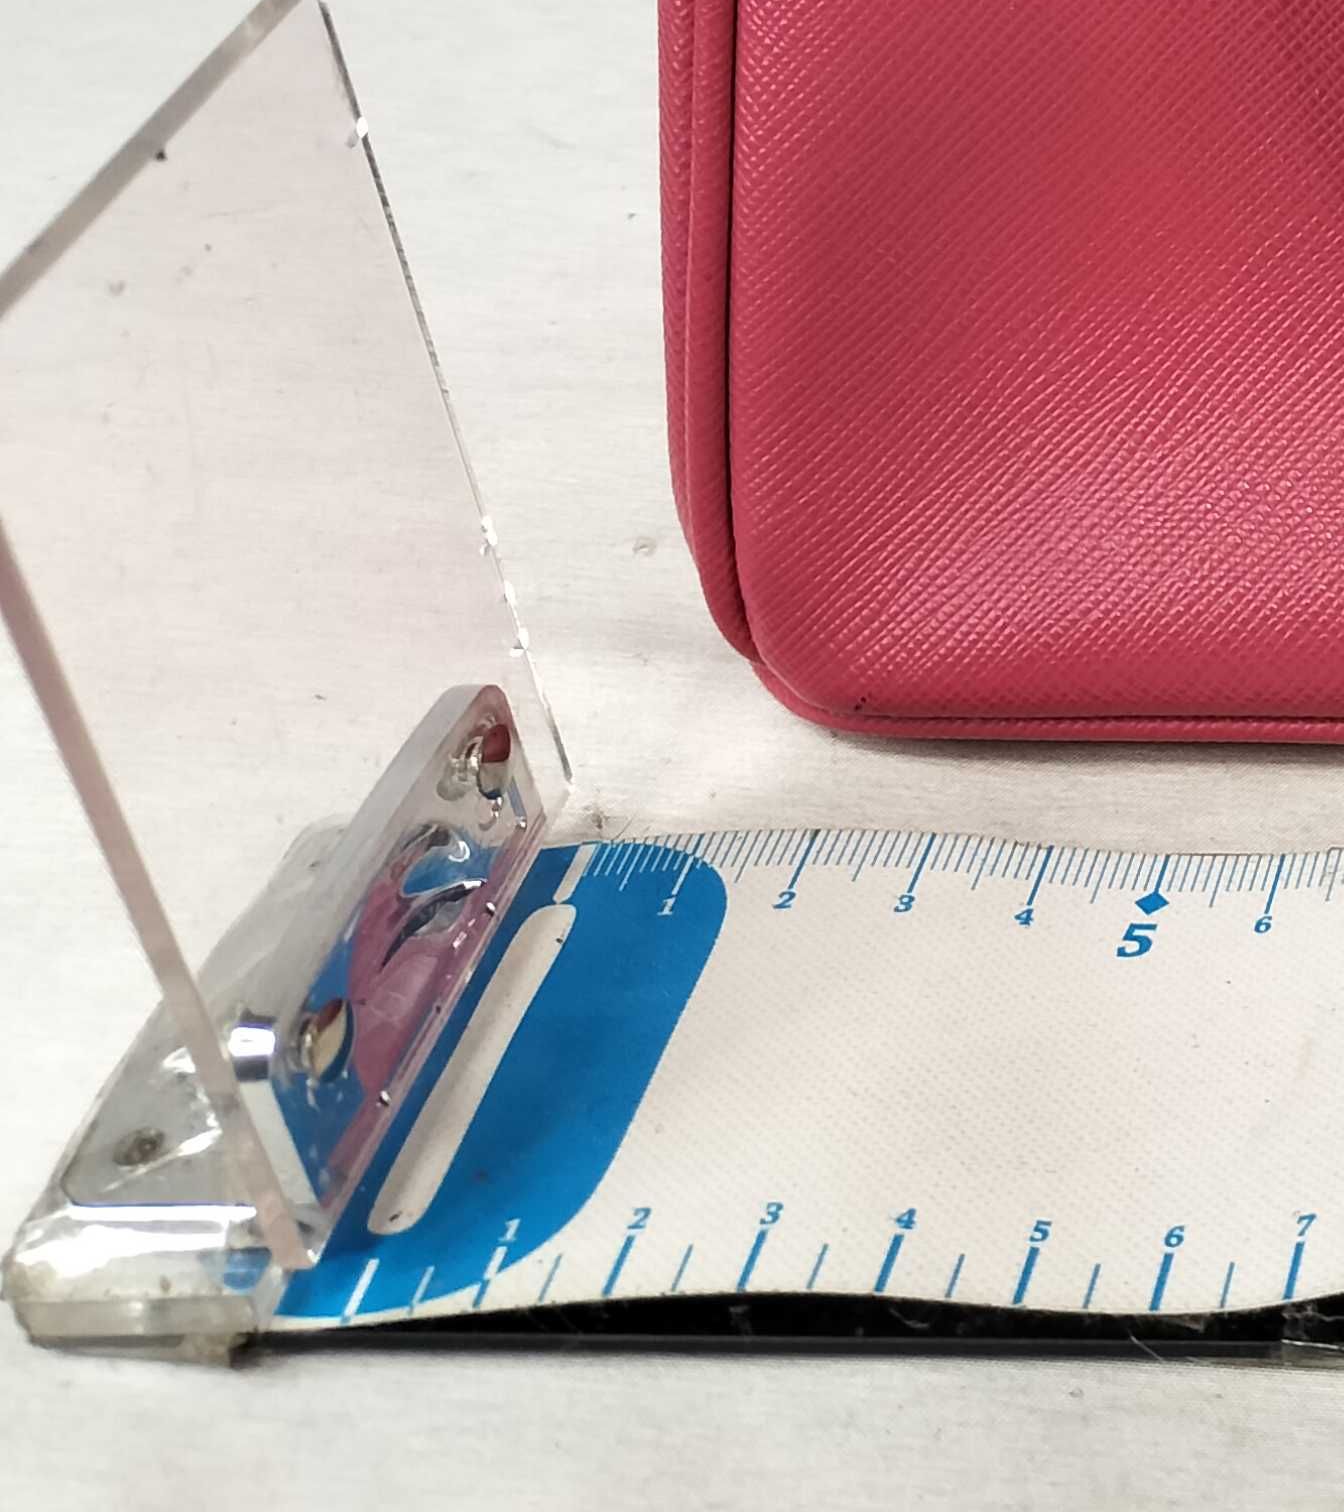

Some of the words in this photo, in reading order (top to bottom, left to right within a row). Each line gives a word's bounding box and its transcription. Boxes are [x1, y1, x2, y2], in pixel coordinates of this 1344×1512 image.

[657, 896, 675, 917] 1
[772, 891, 797, 911] 2
[893, 893, 916, 915] 3
[1013, 908, 1035, 927] 4
[1115, 924, 1158, 959] 5
[1252, 914, 1273, 934] 6
[498, 1218, 523, 1242] 1
[628, 1207, 651, 1230] 2
[760, 1201, 784, 1225] 3
[893, 1208, 919, 1230] 4
[1028, 1220, 1053, 1243] 5
[1163, 1225, 1186, 1249] 6
[1295, 1213, 1318, 1236] 7
